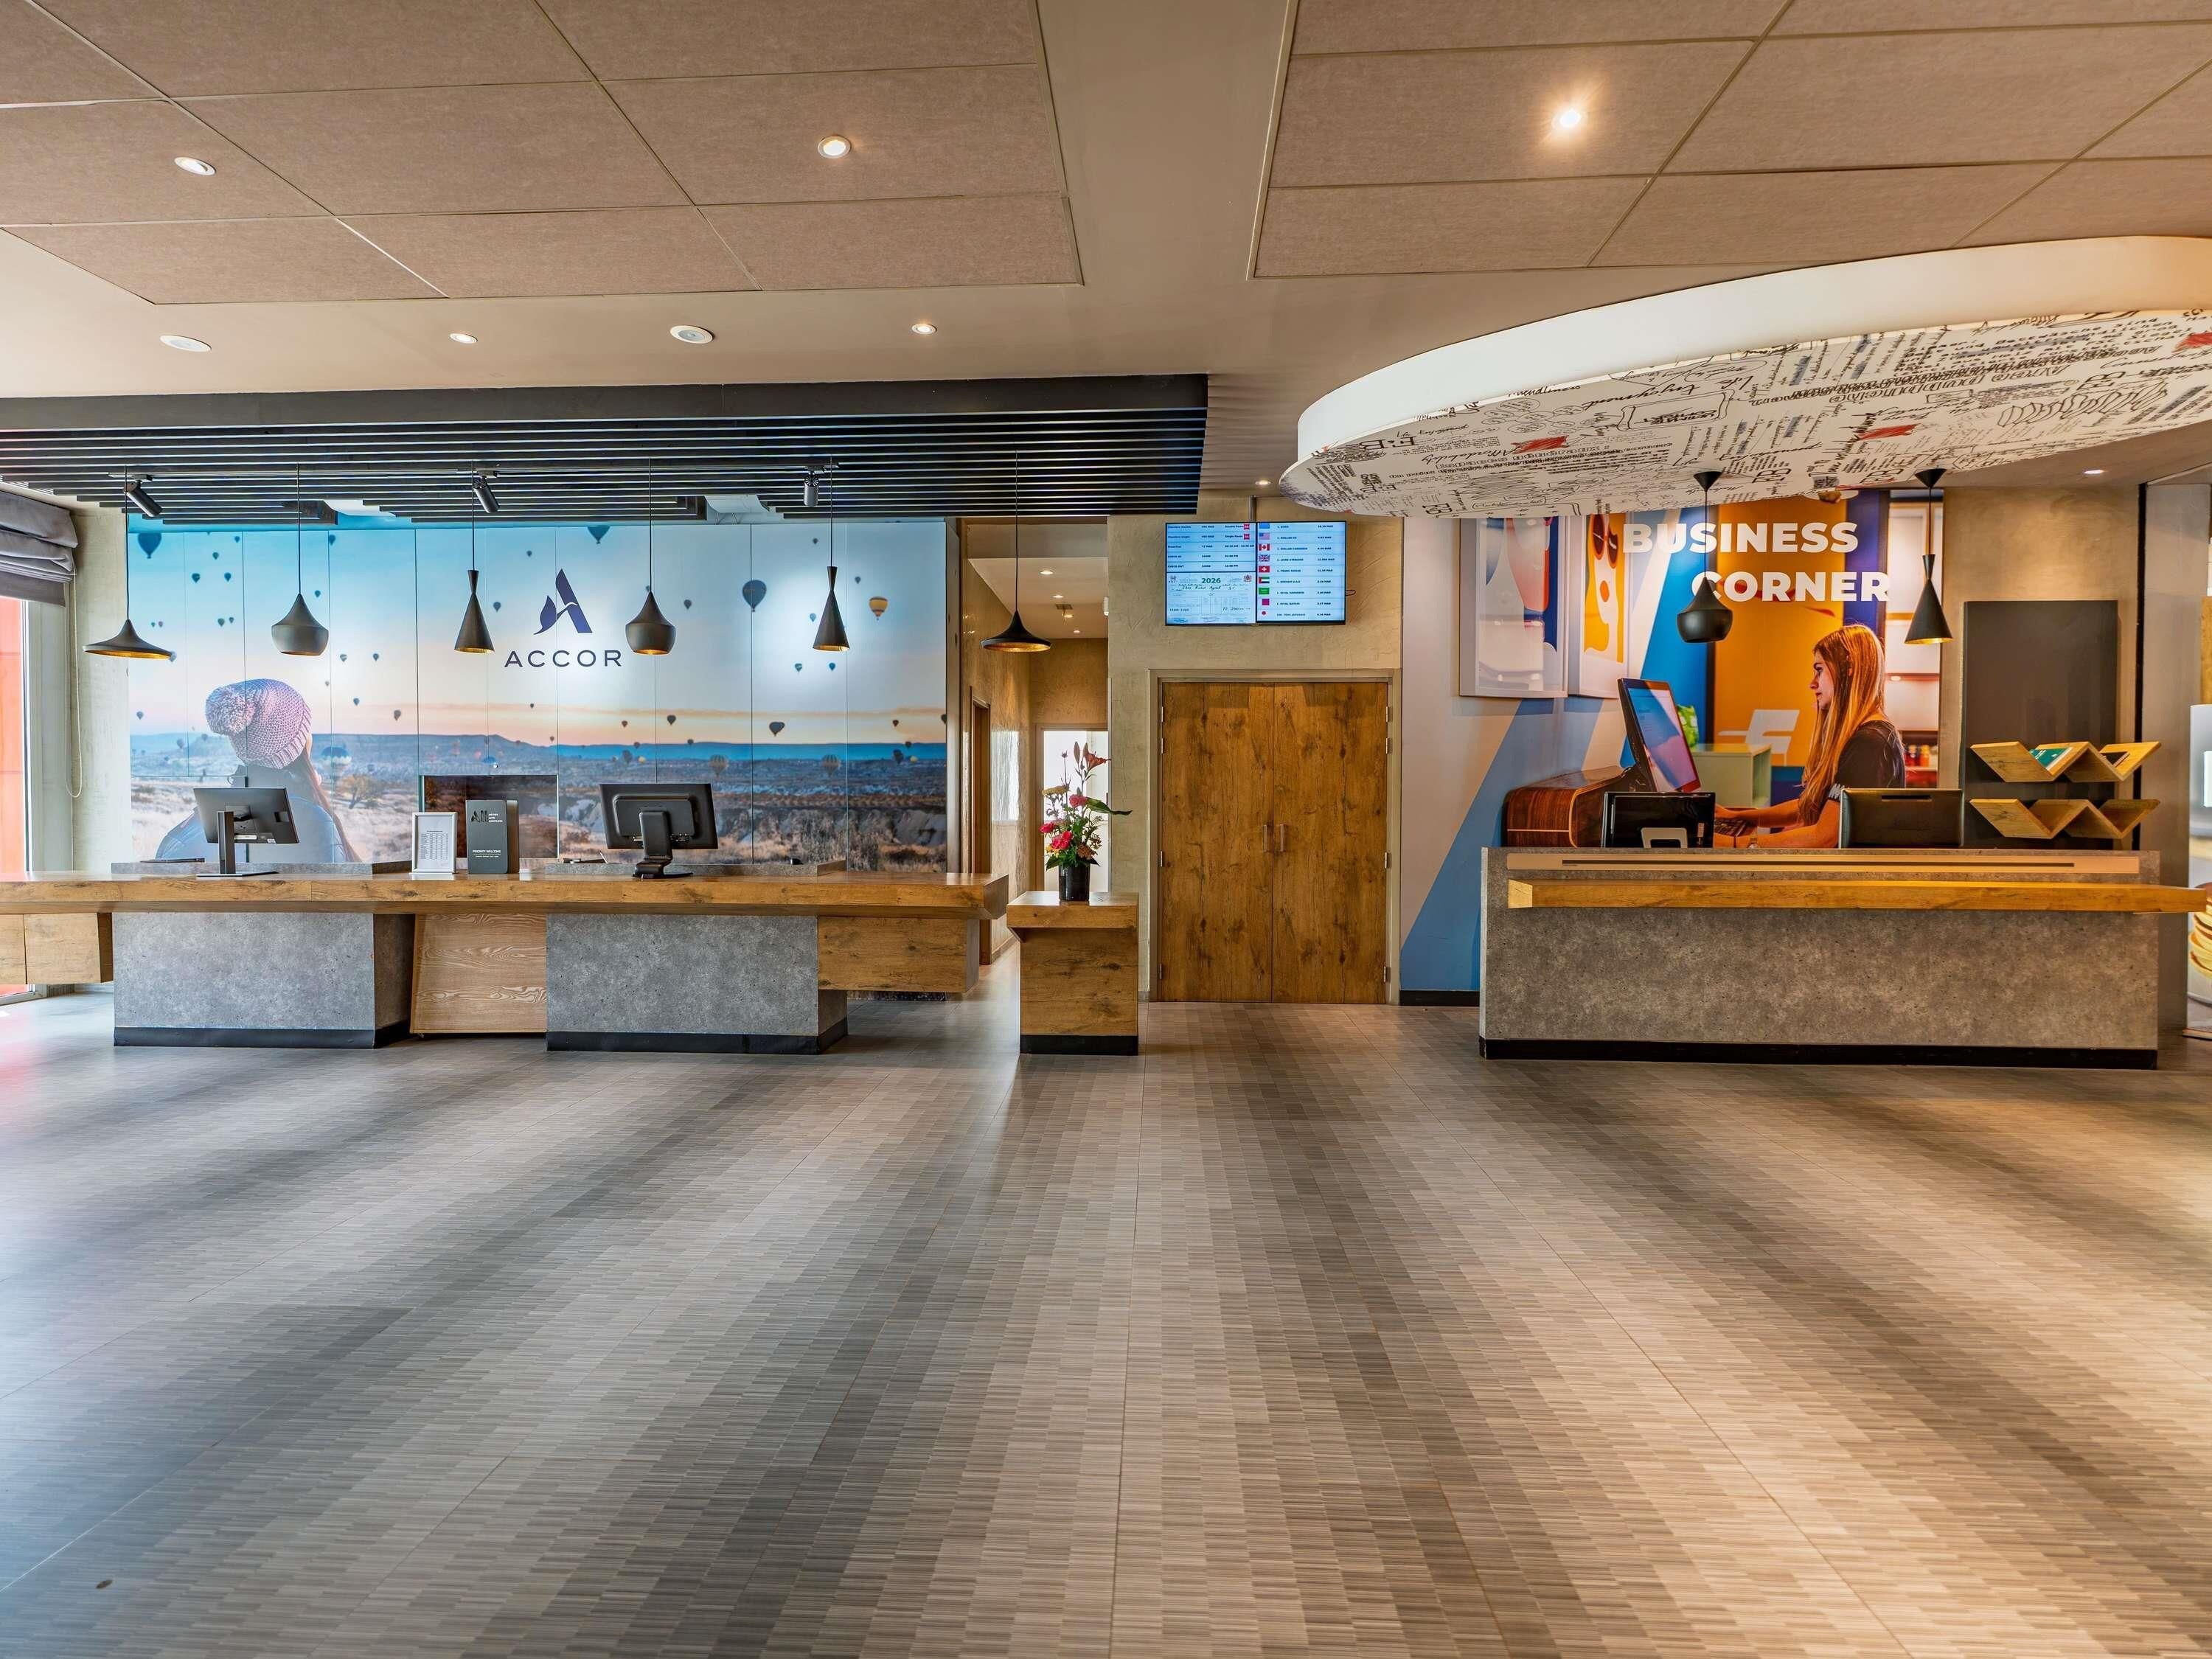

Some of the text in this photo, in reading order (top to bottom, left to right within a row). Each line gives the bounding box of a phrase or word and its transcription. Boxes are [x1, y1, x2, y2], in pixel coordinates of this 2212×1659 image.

[1714, 375, 1754, 390] Life
[1582, 383, 1699, 411] Enjoyment
[1422, 446, 1520, 465] Affordability
[1622, 522, 1859, 553] BUSINESS
[1691, 571, 1890, 602] CORNER
[504, 650, 622, 667] ACCOR
